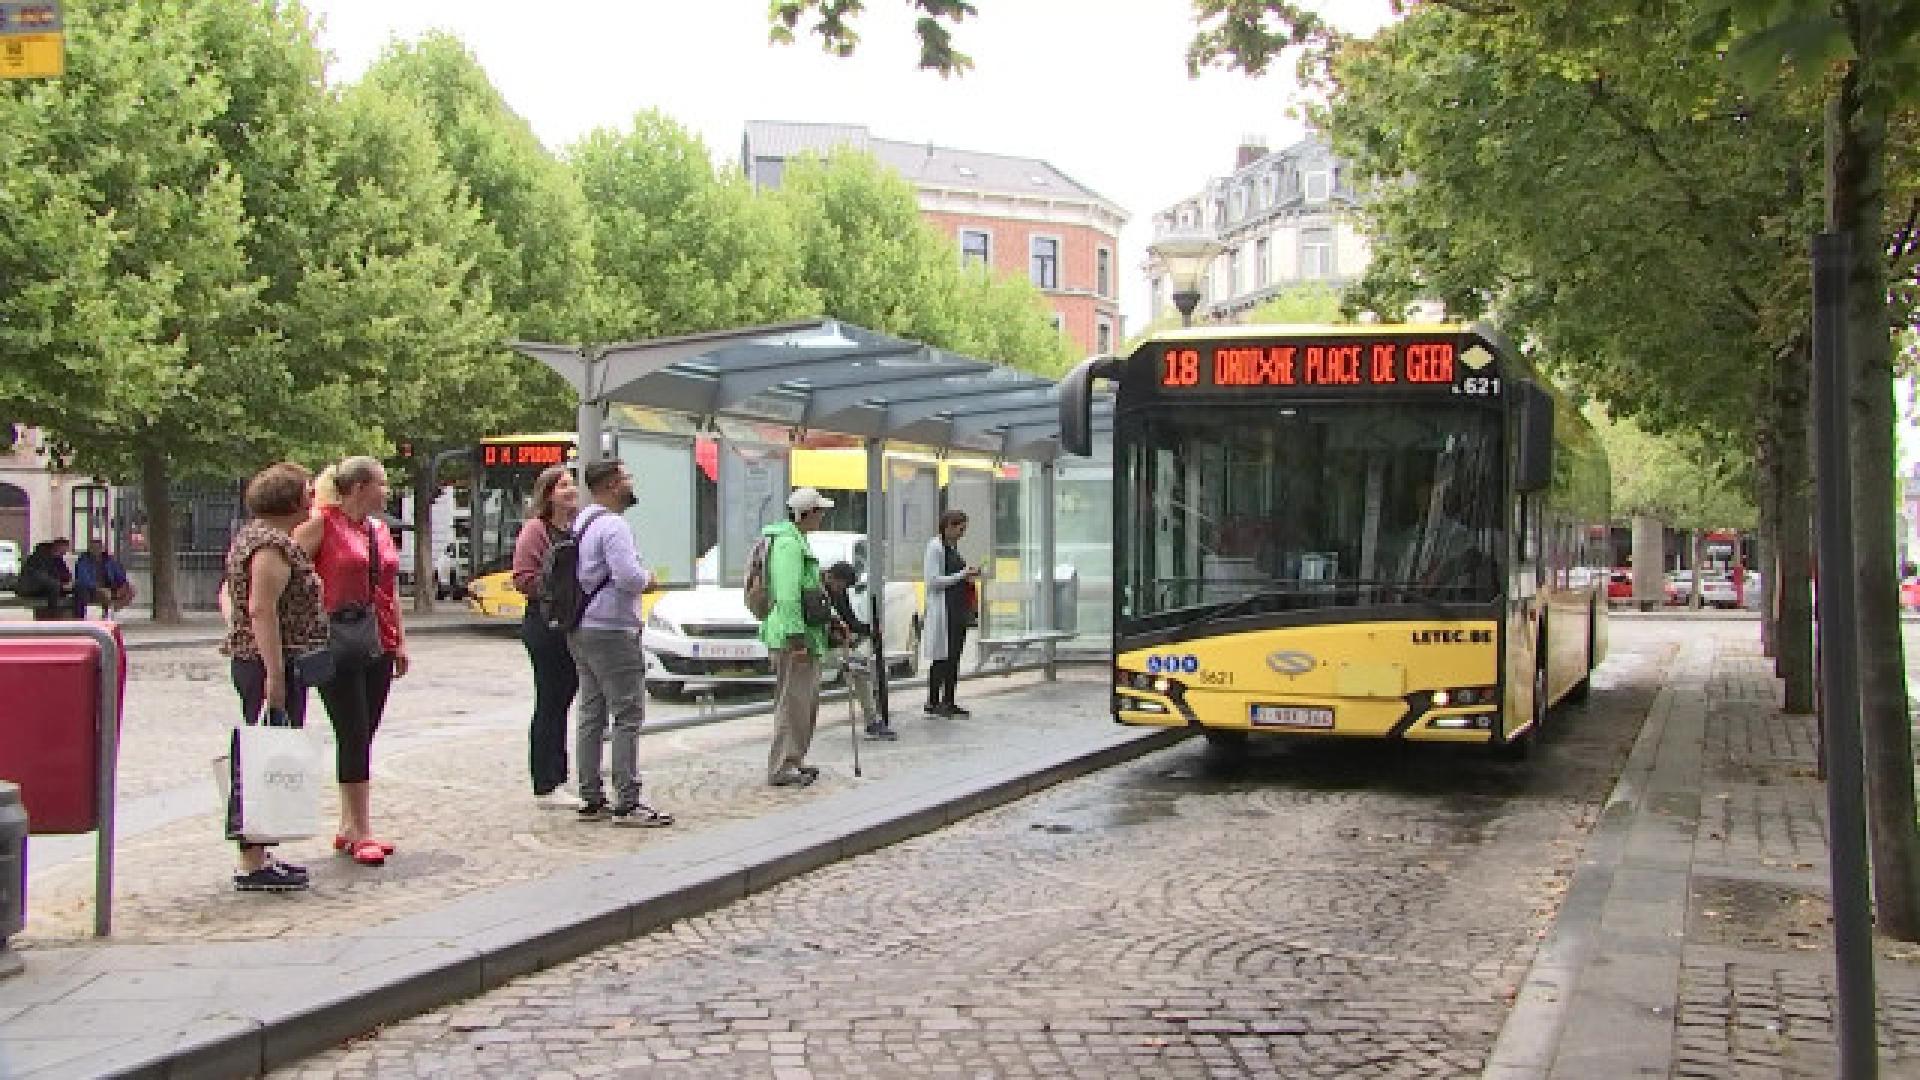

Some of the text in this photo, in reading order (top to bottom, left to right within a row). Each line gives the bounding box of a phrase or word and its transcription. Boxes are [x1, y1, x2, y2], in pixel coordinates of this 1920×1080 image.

[1163, 348, 1199, 385] 18
[1306, 345, 1362, 384] PLACE
[1372, 343, 1396, 382] DE
[1405, 343, 1454, 382] GEER
[1411, 629, 1492, 643] LETEC.BE
